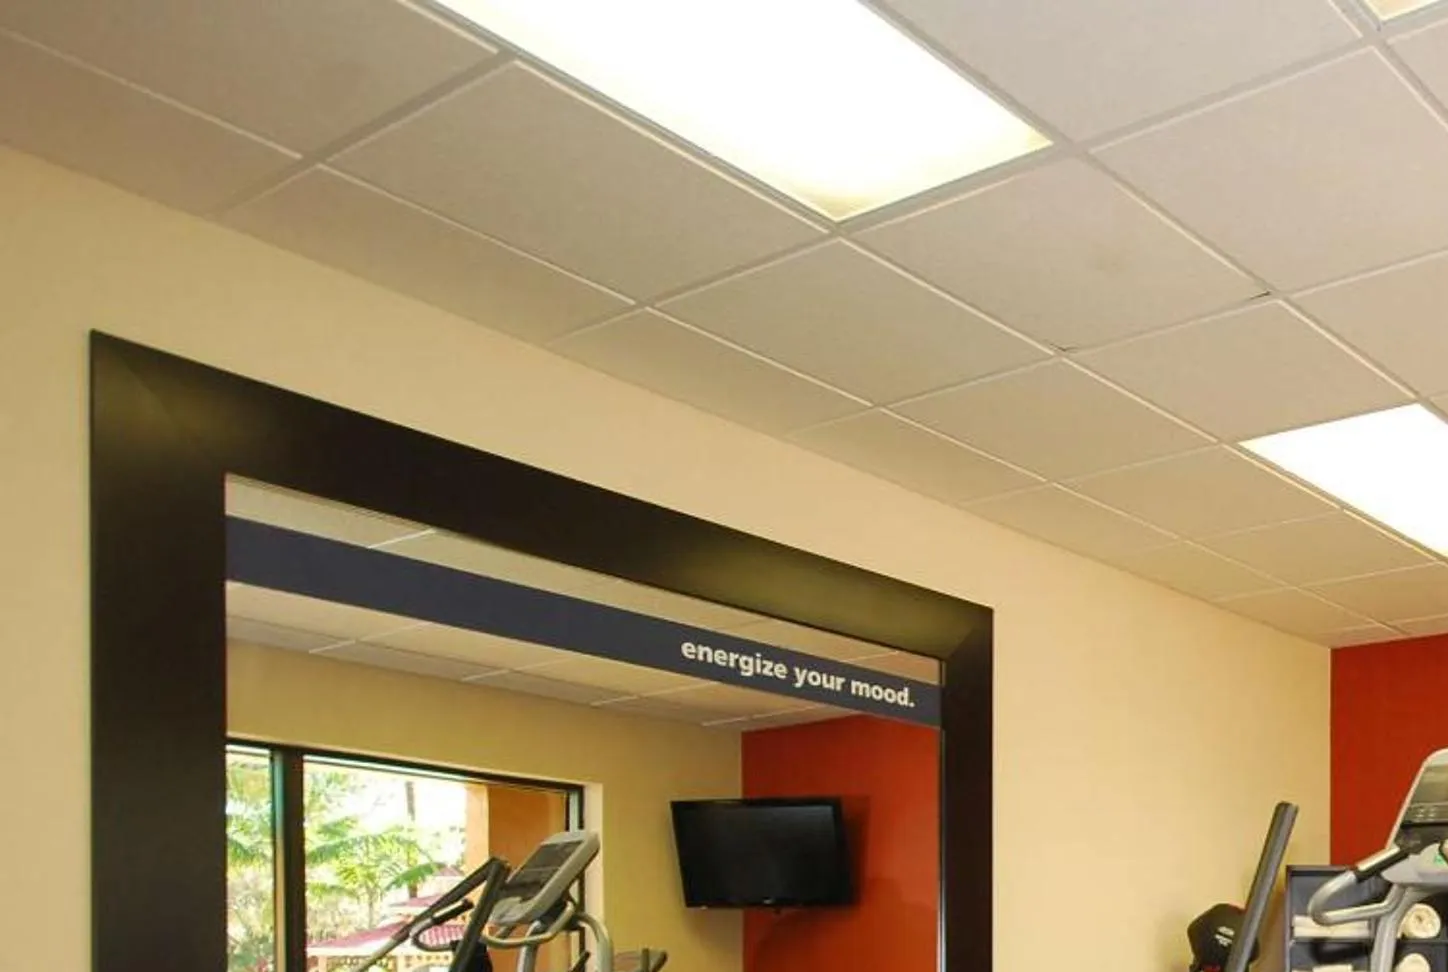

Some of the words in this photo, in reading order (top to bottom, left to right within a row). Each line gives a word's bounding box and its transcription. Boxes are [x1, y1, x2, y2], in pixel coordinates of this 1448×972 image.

[681, 641, 788, 679] energize
[793, 665, 846, 691] your
[851, 680, 916, 708] mood.
